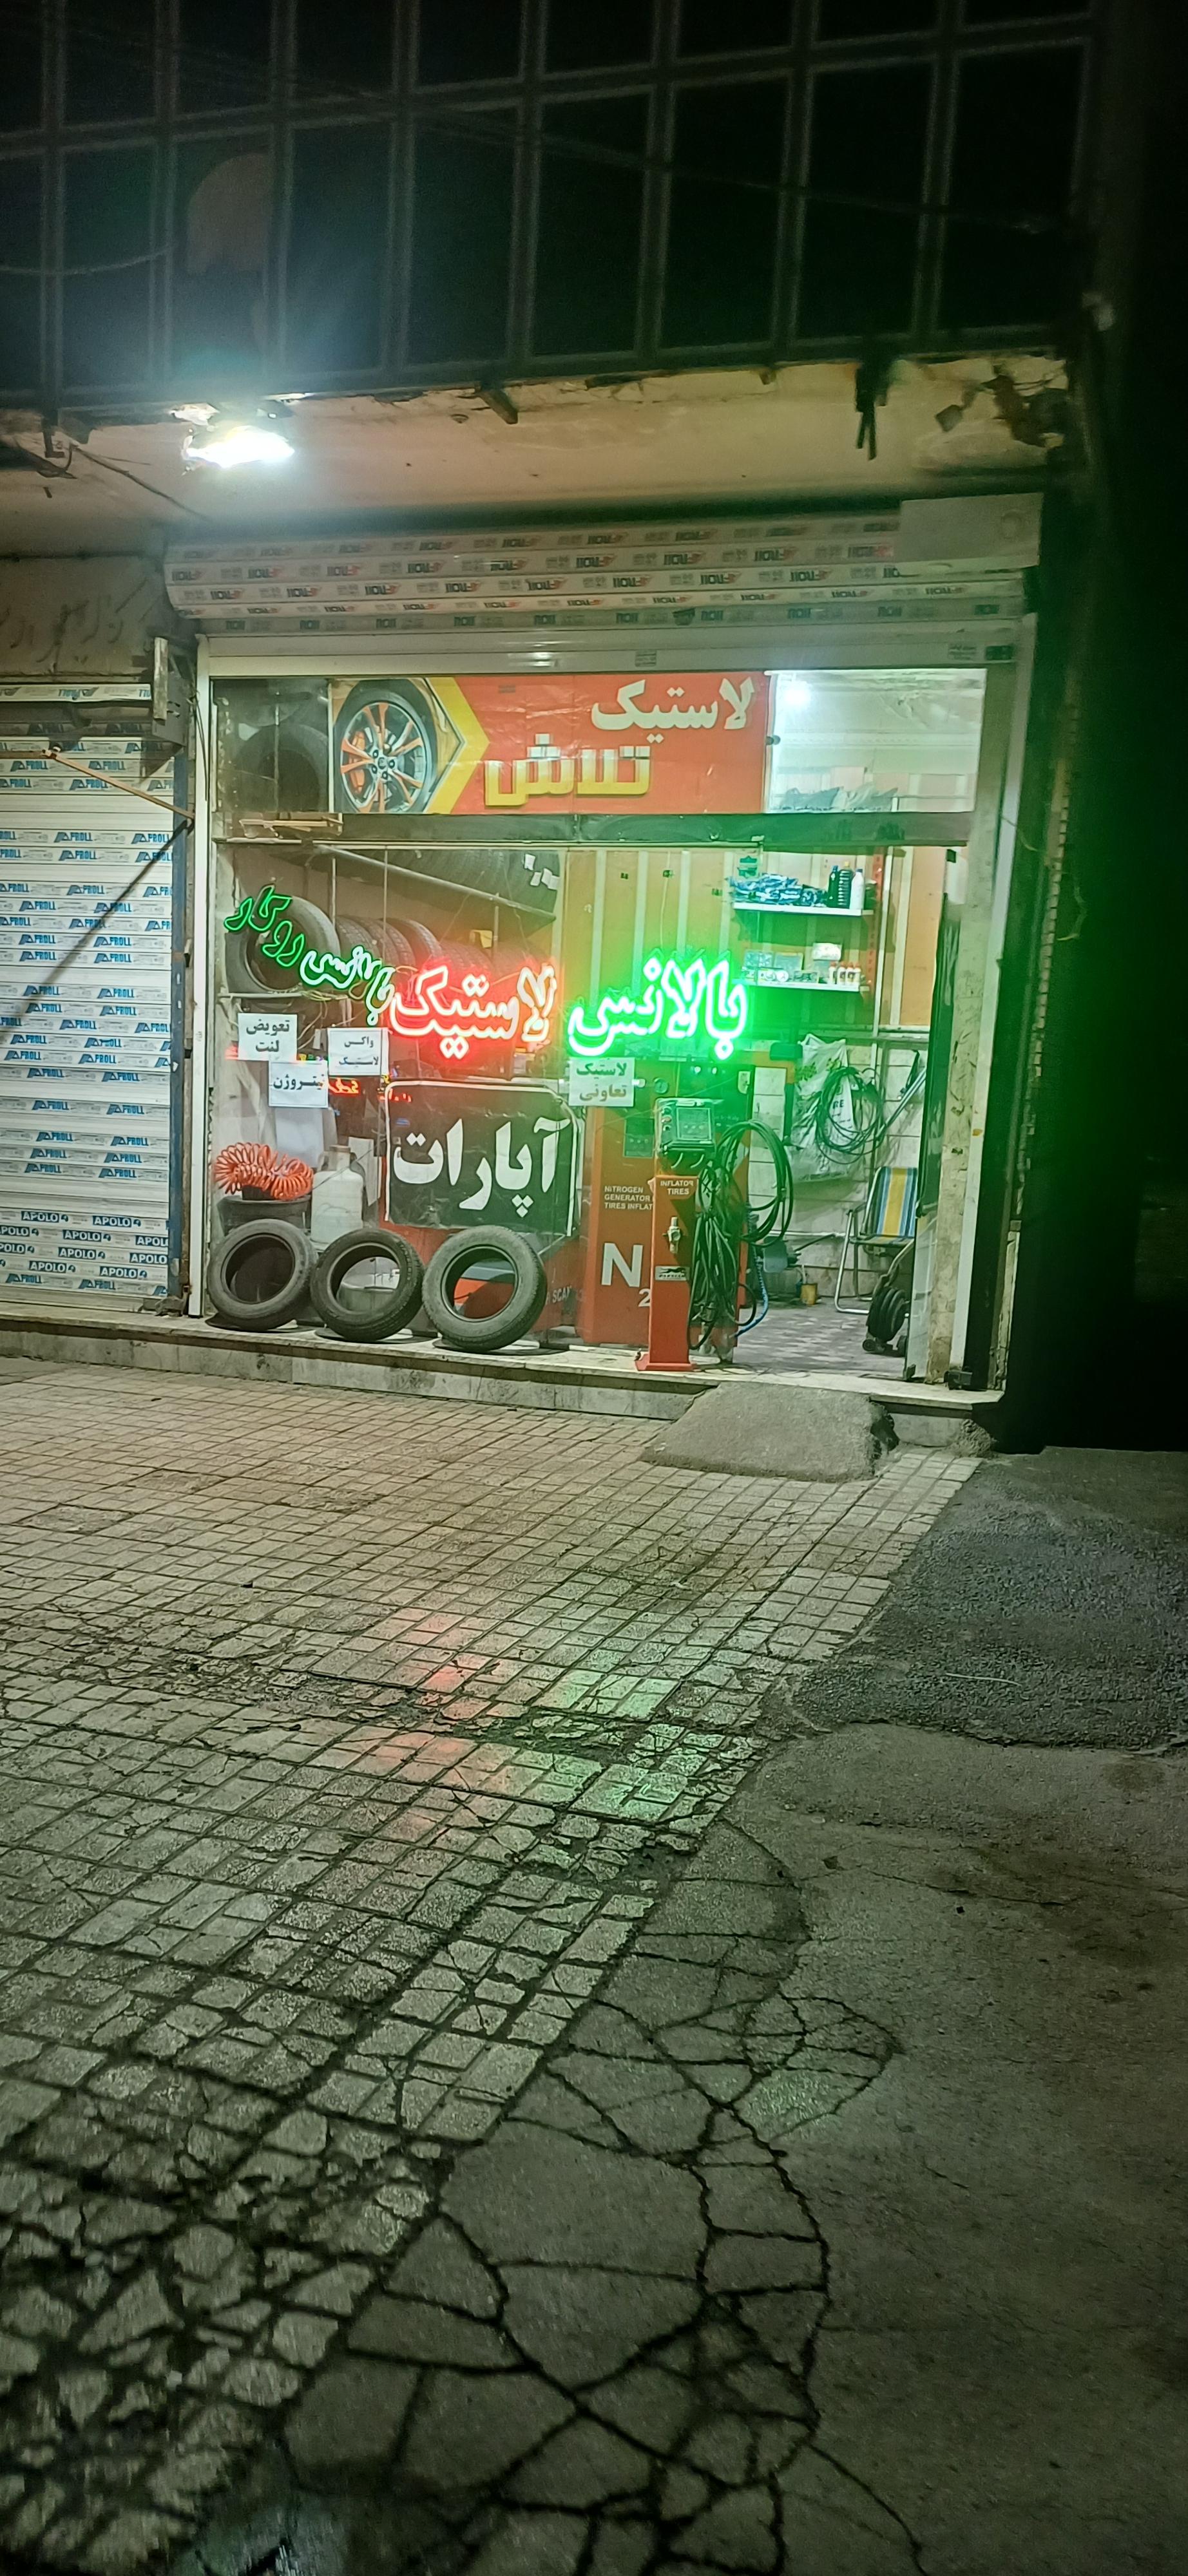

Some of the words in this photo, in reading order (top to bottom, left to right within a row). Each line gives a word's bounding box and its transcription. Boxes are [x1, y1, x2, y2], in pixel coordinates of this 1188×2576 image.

[591, 677, 756, 744] لاستیک
[484, 733, 651, 806] تلاش
[388, 963, 559, 1060] لاستیک
[568, 954, 750, 1061] بالانس
[246, 1019, 290, 1036] تعویض
[255, 1038, 280, 1054] لنت
[343, 1036, 374, 1048] واکس
[339, 1056, 379, 1068] لاستیک
[576, 1061, 628, 1079] لاستیک
[273, 1071, 325, 1090] نیتروژن
[579, 1083, 628, 1102] تعاونی
[393, 1115, 571, 1218] آپارات
[604, 1185, 644, 1194] NITROGEN
[604, 1193, 651, 1202] GENERATOR
[604, 1202, 626, 1210] TIRES
[22, 1211, 59, 1222] APOLO
[93, 1217, 132, 1227] APOLO
[64, 1231, 101, 1242] APOLO
[59, 1248, 96, 1260] APOLO
[131, 1253, 168, 1264] APOLO
[30, 1262, 67, 1273] APOLO
[101, 1267, 138, 1278] APOLO
